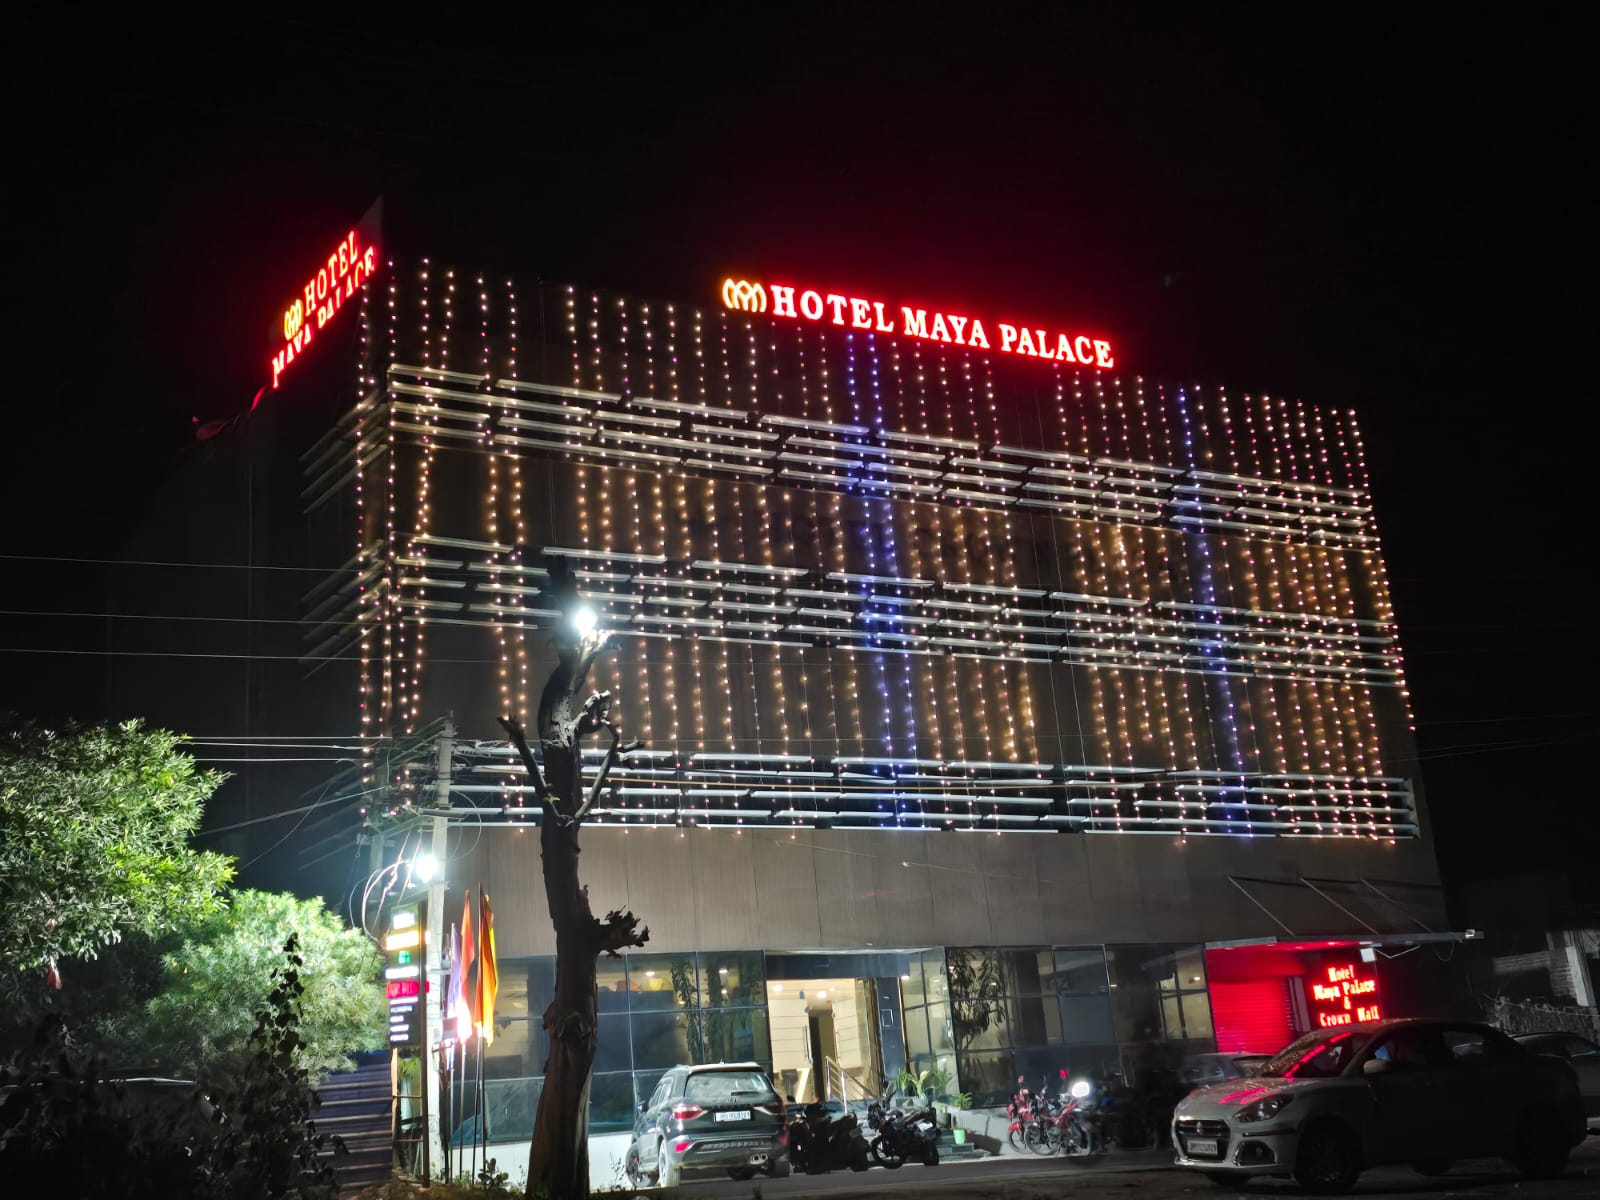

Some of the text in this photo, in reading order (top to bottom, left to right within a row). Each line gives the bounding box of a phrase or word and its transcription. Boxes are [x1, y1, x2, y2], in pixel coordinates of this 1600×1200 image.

[303, 230, 358, 317] HOTEL
[769, 284, 1114, 369] HOTEL MAYA PALACE
[1342, 979, 1375, 995] Palace
[1319, 1012, 1352, 1027] Crown
